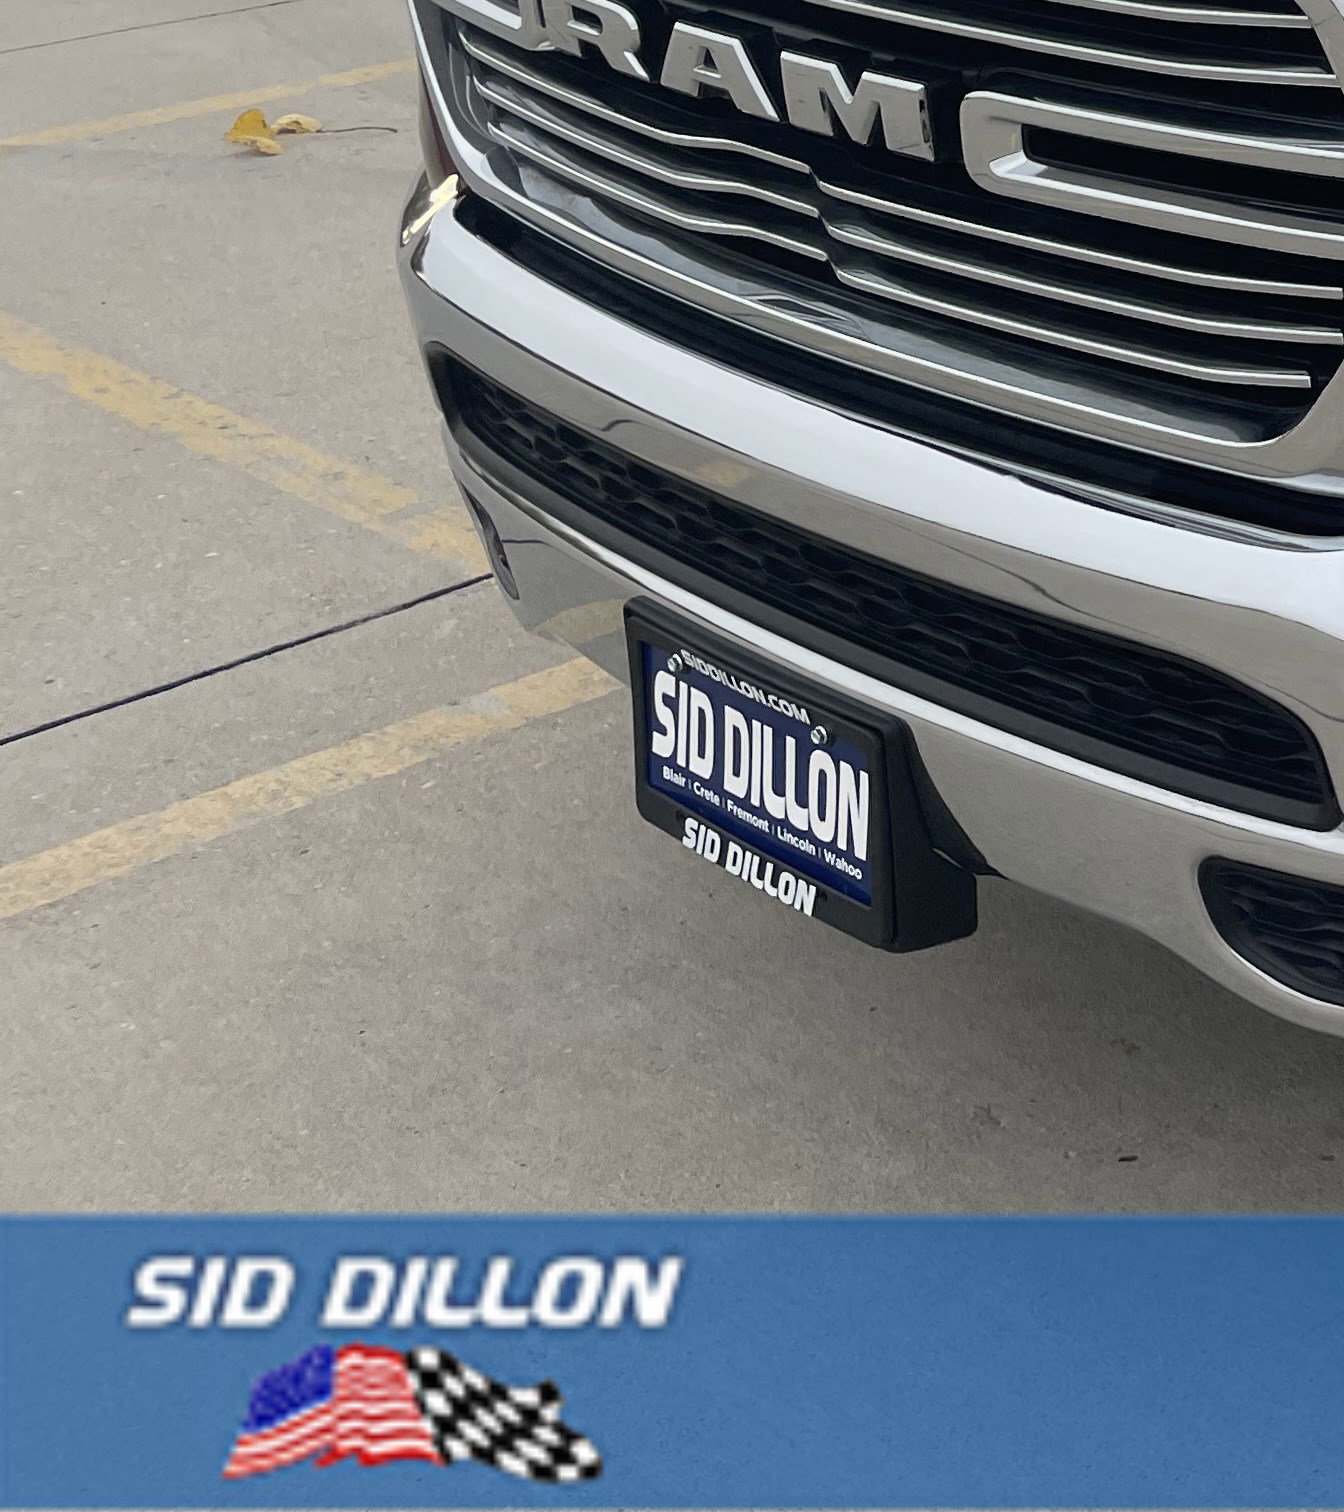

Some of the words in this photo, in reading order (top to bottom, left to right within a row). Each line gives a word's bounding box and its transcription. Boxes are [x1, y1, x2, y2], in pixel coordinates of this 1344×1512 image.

[680, 649, 810, 726] SIDDILLON.COM
[652, 669, 715, 781] SID
[723, 704, 870, 862] DILLON
[662, 765, 687, 789] Blair
[692, 781, 721, 807] Crete
[726, 799, 770, 835] Fremont
[776, 824, 817, 856] Lincoln
[823, 847, 863, 881] Wahoo
[681, 816, 721, 864] SID
[725, 844, 818, 917] DILLON
